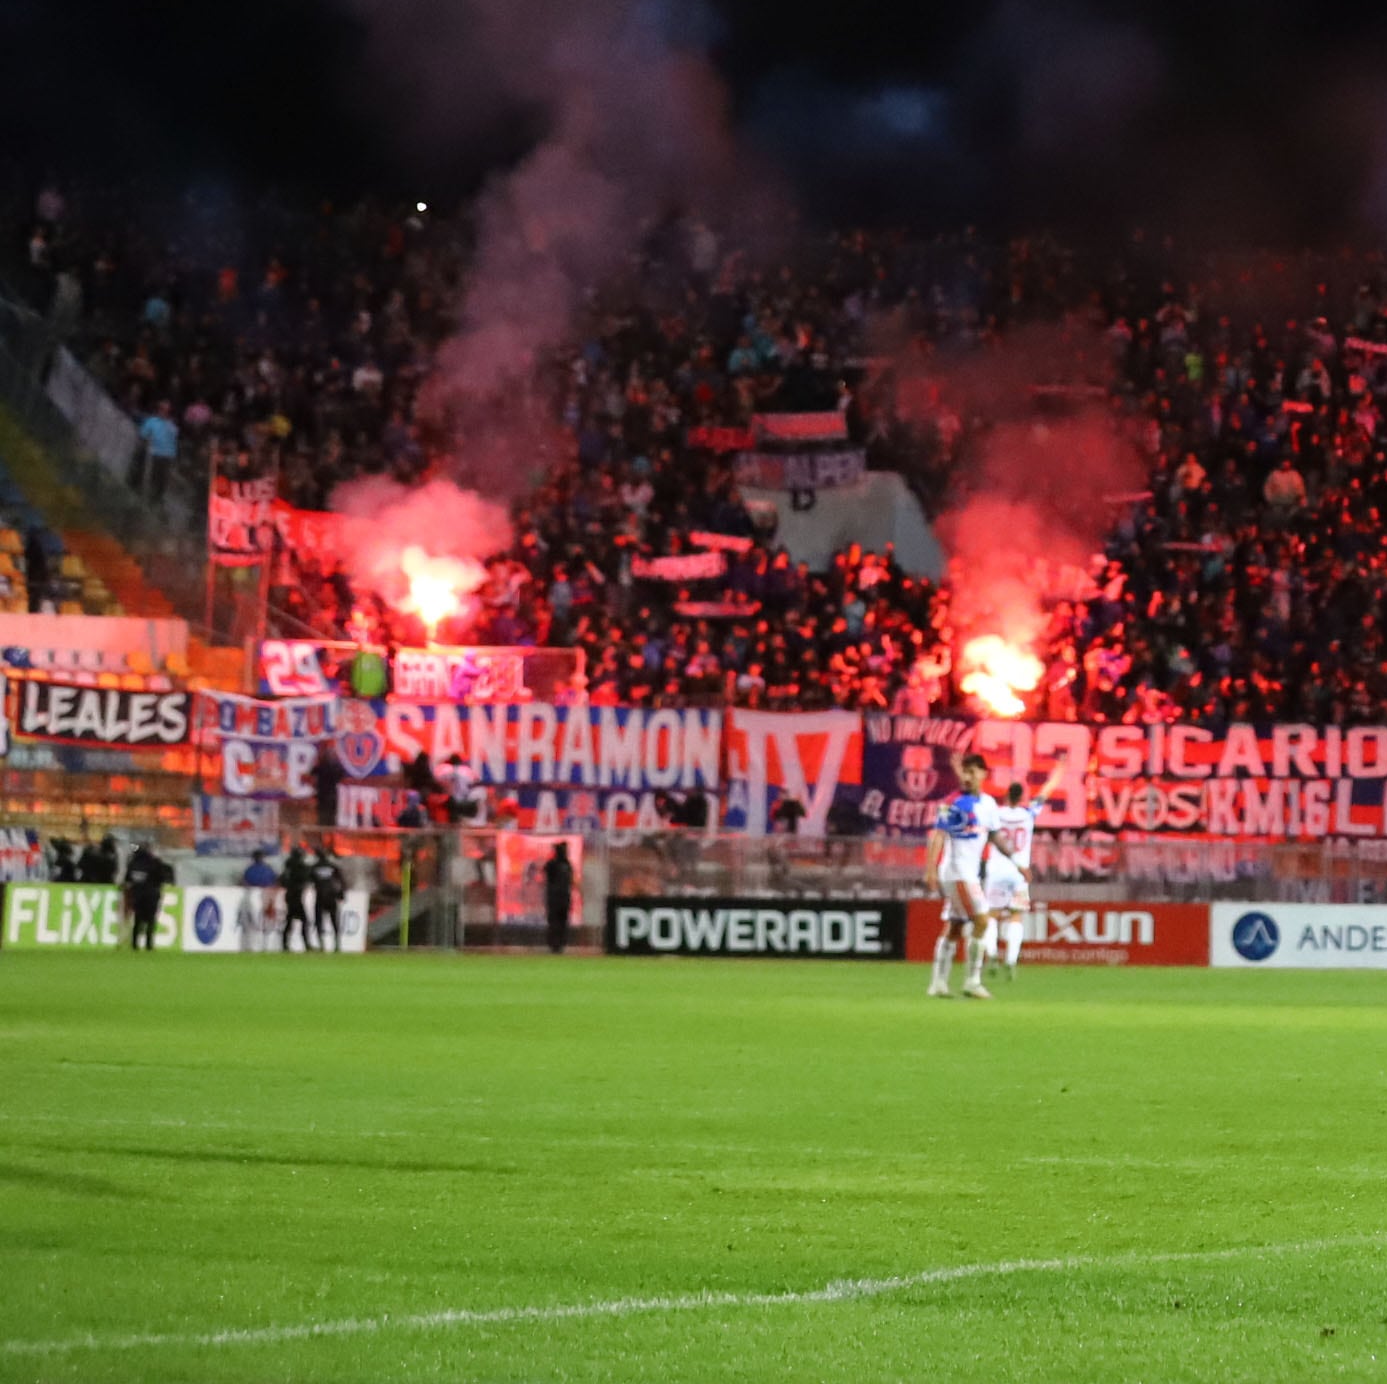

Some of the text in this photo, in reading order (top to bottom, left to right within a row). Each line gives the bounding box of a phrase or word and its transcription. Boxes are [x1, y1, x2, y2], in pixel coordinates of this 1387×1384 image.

[22, 681, 188, 744] LEALES
[516, 706, 719, 791] RAMON
[8, 887, 181, 946] FLiXS
[615, 907, 883, 954] POWERADE
